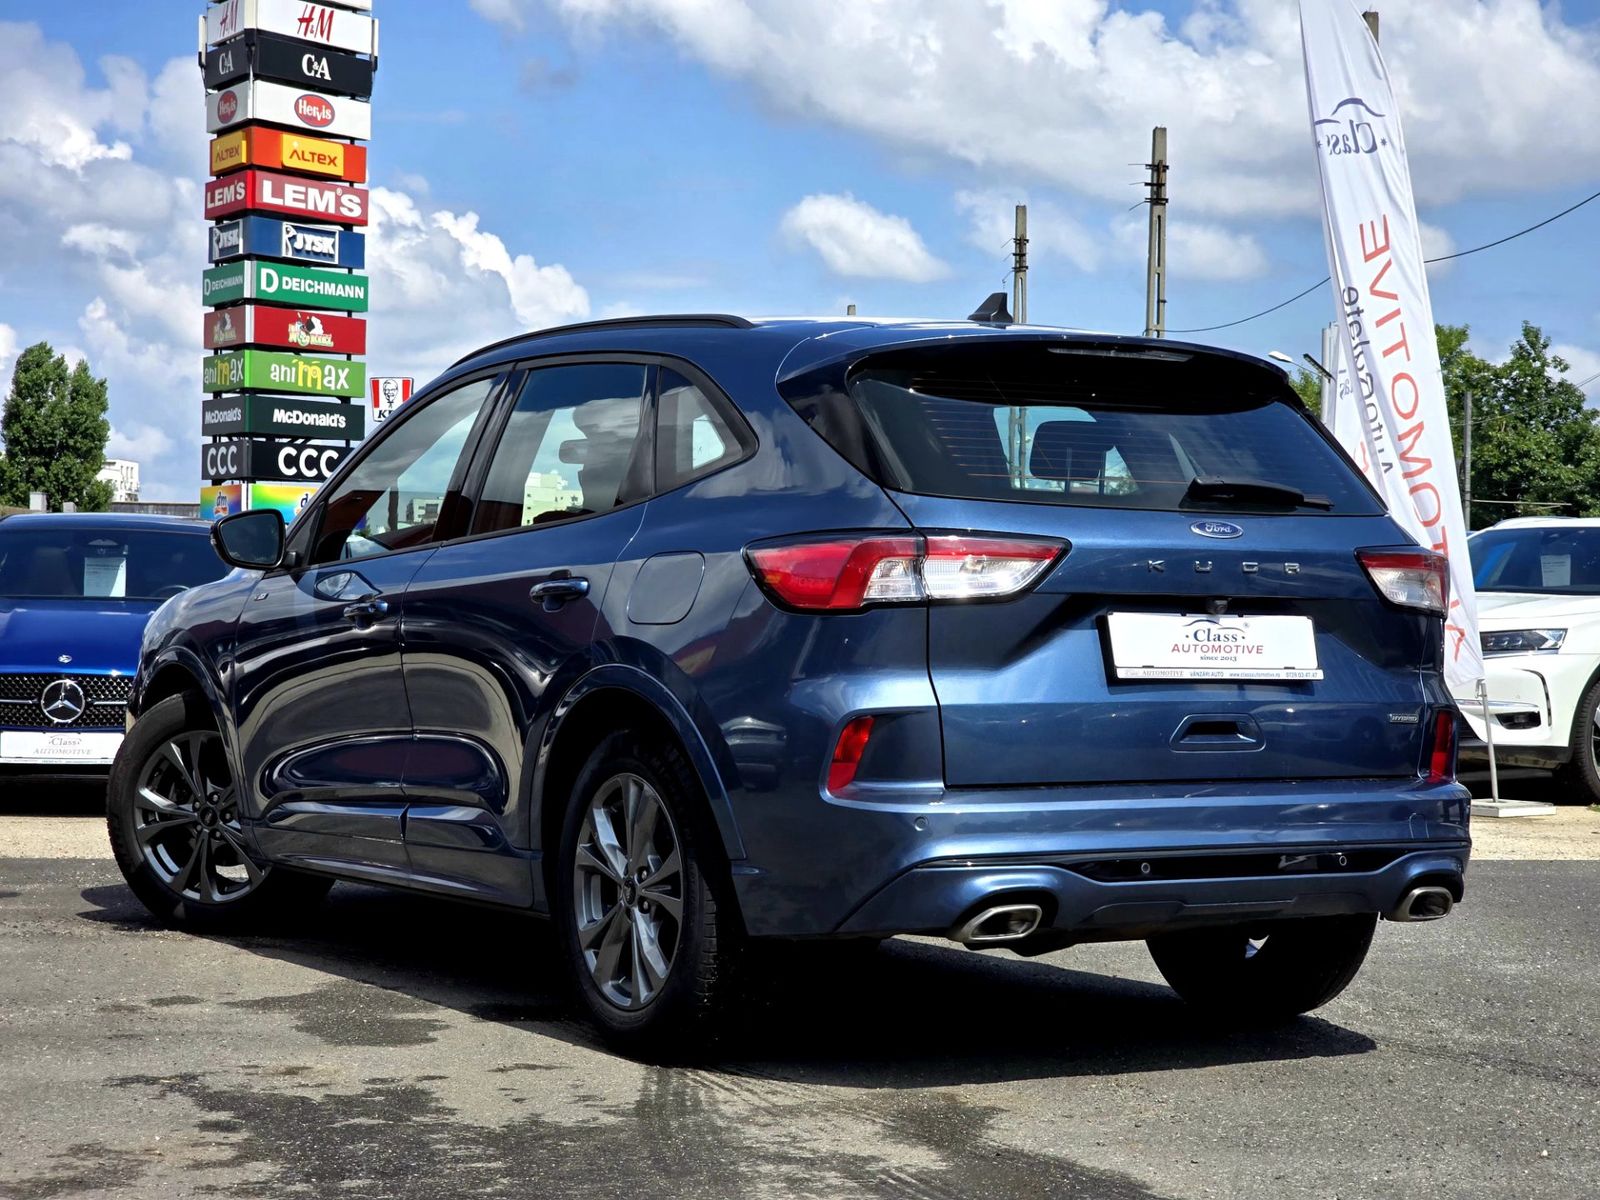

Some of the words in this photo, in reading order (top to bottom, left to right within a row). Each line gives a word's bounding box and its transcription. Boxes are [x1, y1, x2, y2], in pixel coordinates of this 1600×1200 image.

[297, 4, 335, 42] H&M
[301, 53, 331, 81] C&A
[297, 98, 332, 121] Hervis
[294, 231, 336, 255] JYSK
[212, 275, 244, 291] DEICHMANN
[260, 268, 279, 293] D
[282, 277, 365, 299] DEICHMANN
[204, 358, 244, 386] animax
[270, 360, 350, 391] animax
[205, 408, 242, 424] McDonald's
[273, 408, 347, 428] McDonald's
[207, 445, 238, 475] CCC
[278, 446, 340, 478] CCC
[1205, 522, 1233, 533] Ford
[1193, 628, 1238, 643] Class
[1171, 643, 1264, 655] AUTOMOTIVE
[51, 737, 77, 746] Class
